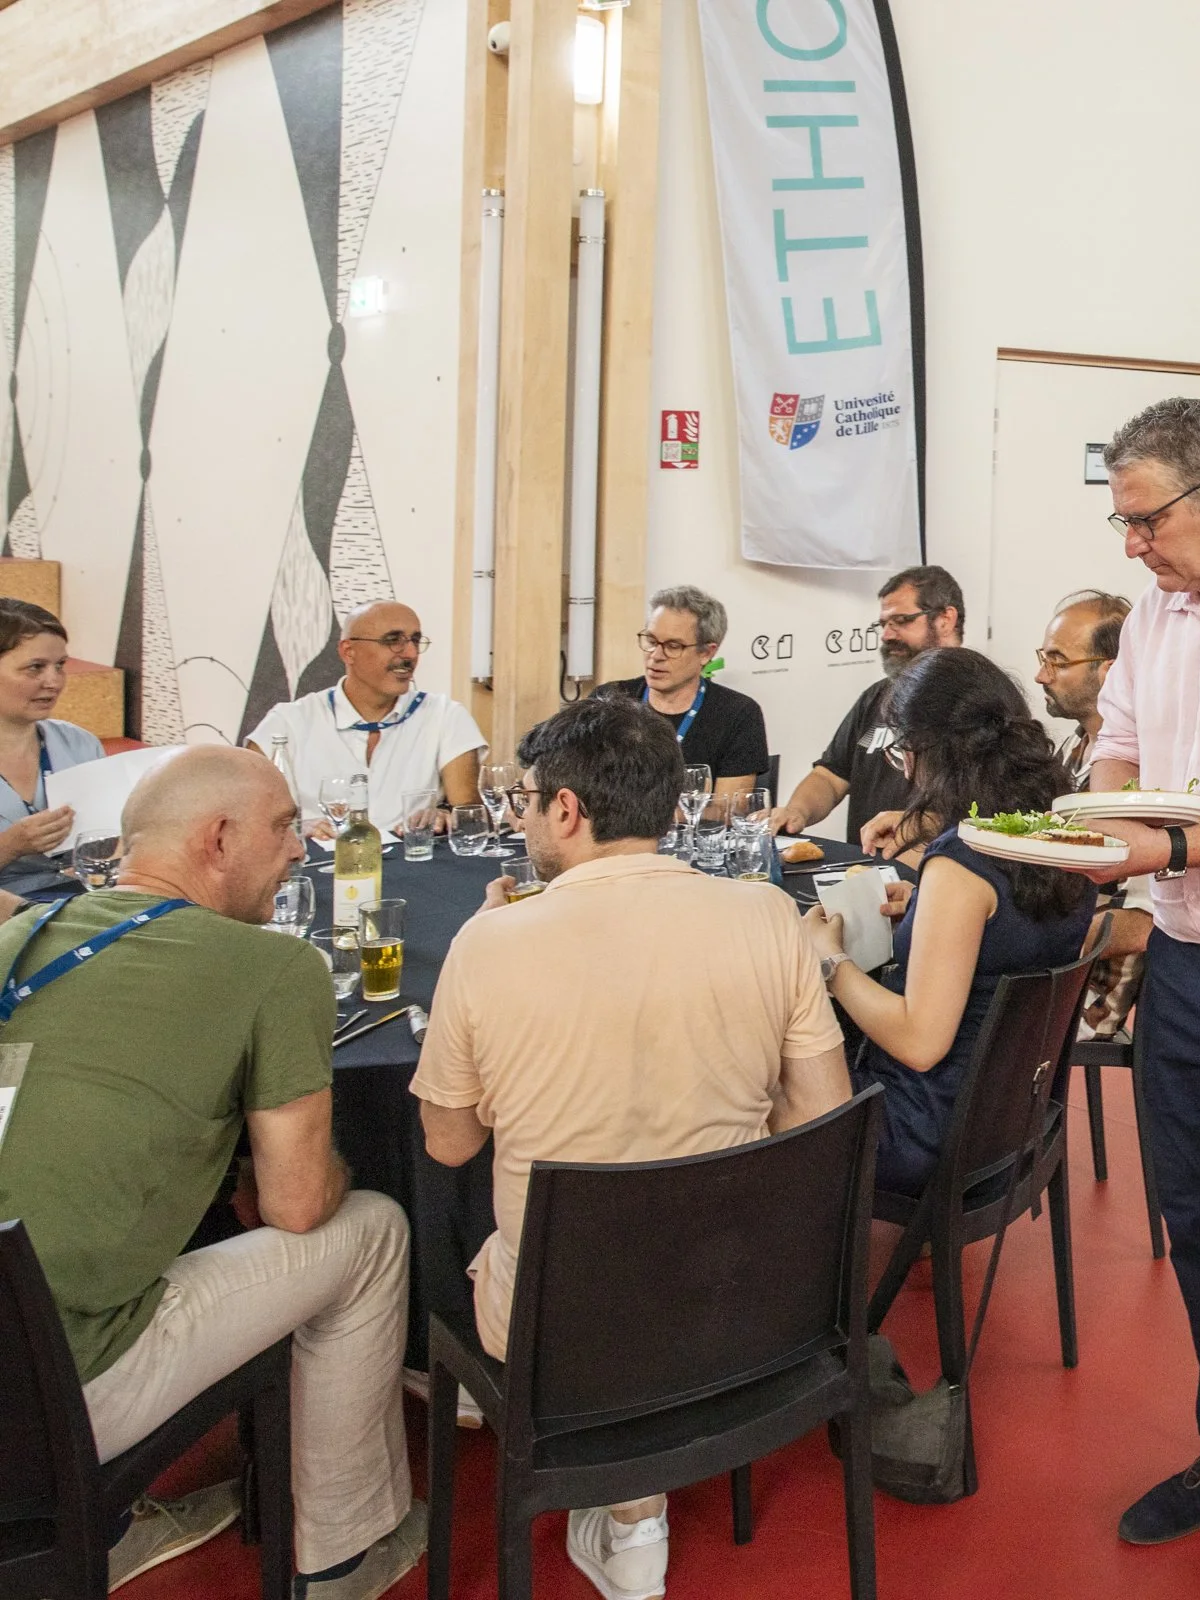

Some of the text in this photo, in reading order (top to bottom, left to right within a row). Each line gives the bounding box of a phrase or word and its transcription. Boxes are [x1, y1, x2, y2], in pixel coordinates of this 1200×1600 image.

[835, 405, 901, 424] Catholique
[835, 425, 853, 437] de
[855, 421, 879, 435] Lille
